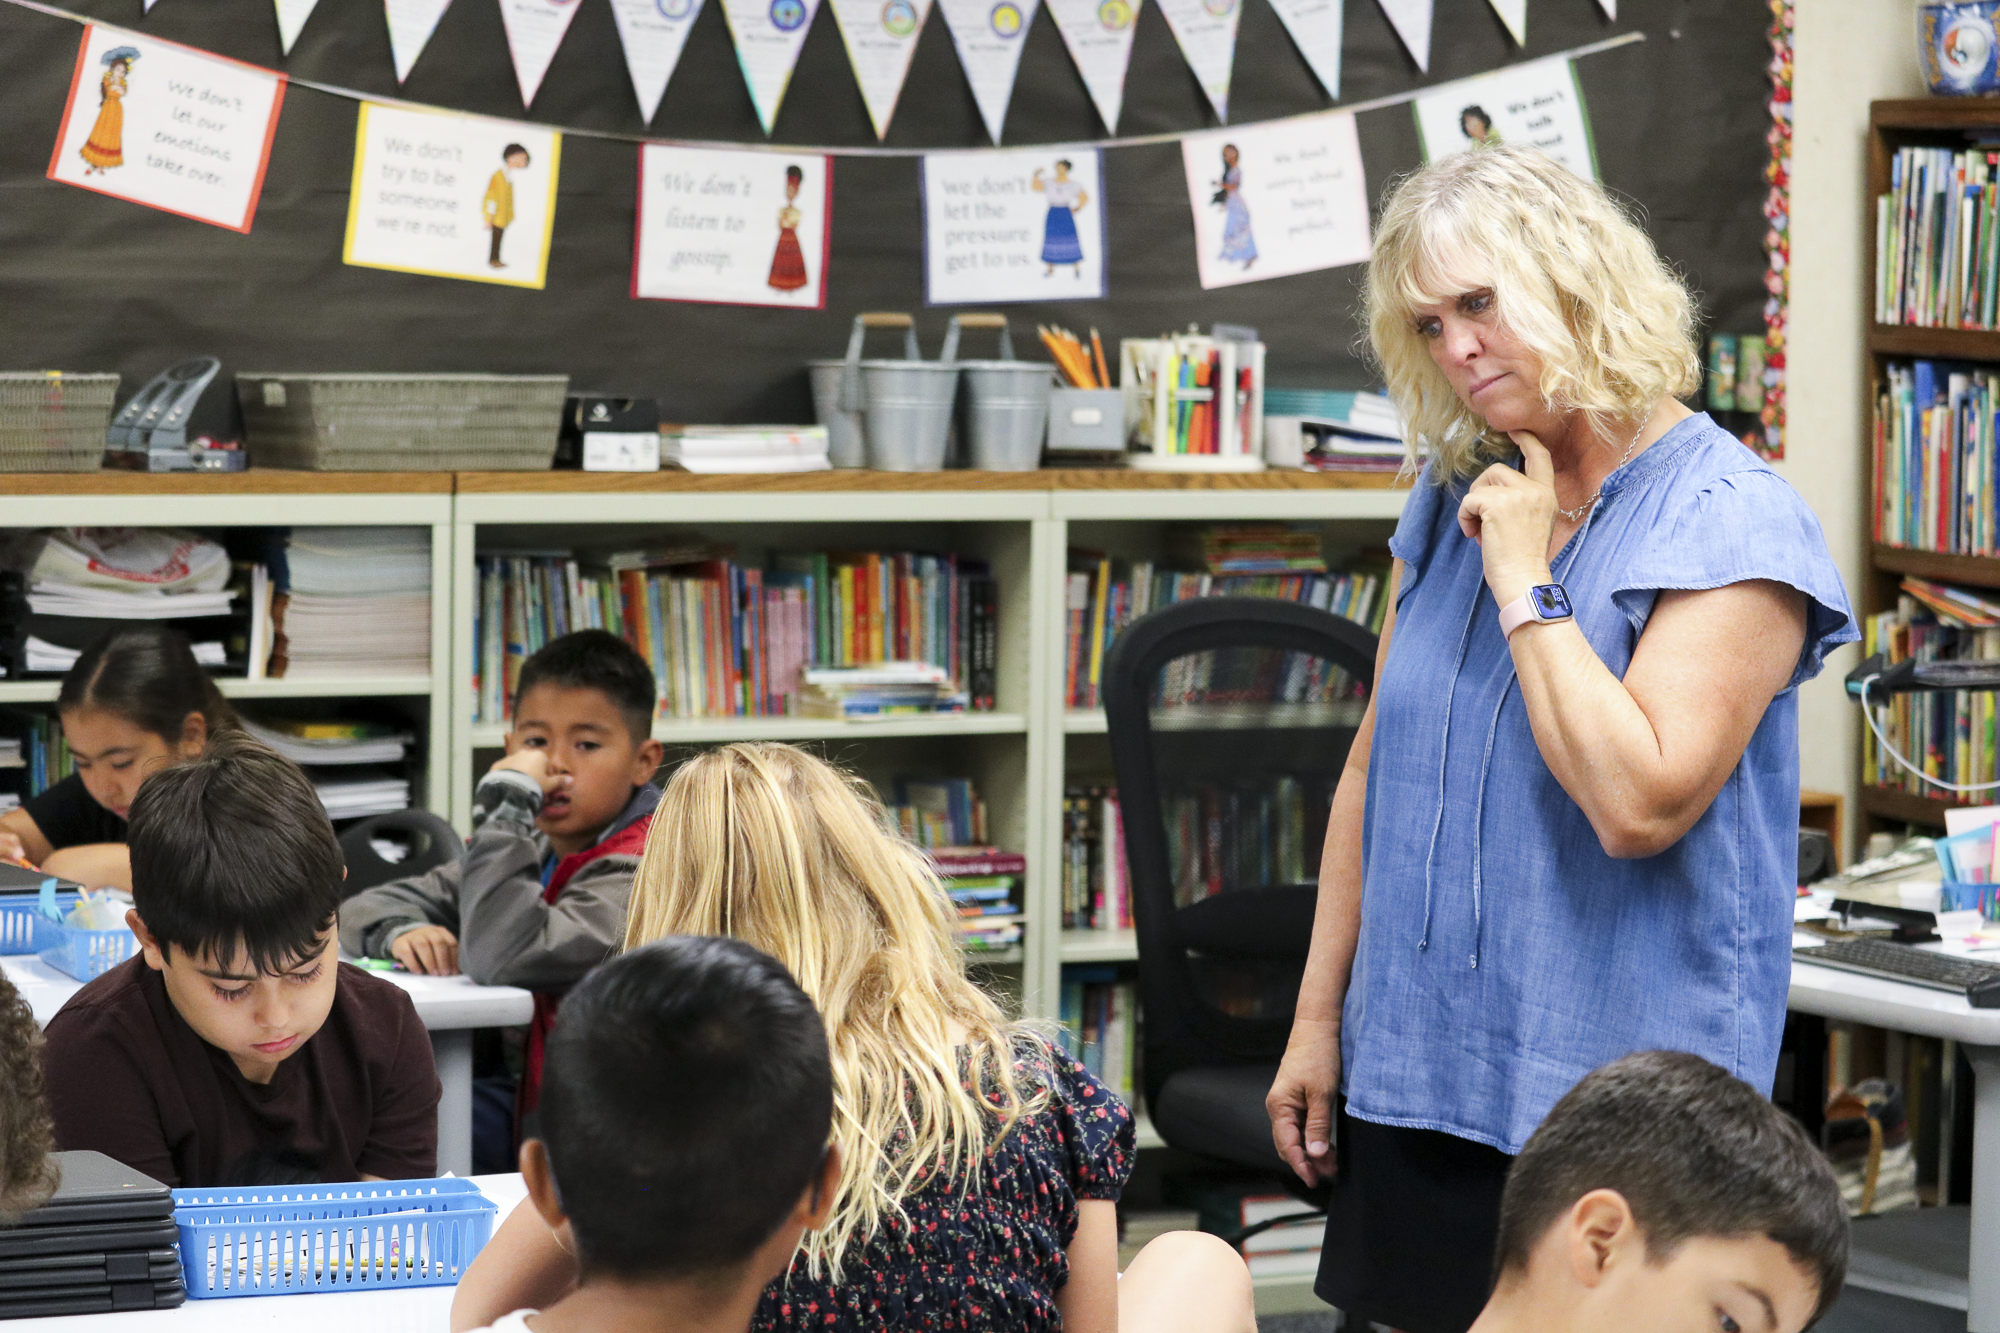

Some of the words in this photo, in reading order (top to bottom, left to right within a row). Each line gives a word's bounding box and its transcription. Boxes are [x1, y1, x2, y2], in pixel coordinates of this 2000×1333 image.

[168, 79, 195, 98] We
[198, 87, 243, 112] don't
[172, 106, 192, 124] let
[197, 117, 227, 132] our
[1505, 103, 1526, 115] We
[154, 131, 232, 162] emotions
[384, 136, 412, 156] We
[417, 142, 463, 163] don't
[146, 154, 184, 175] take
[382, 164, 406, 183] try
[411, 167, 428, 184] to
[434, 169, 455, 187] be
[661, 172, 696, 193] We
[700, 173, 752, 197] don't
[976, 176, 1028, 196] don't
[378, 190, 459, 214] someone
[943, 202, 969, 220] let
[974, 201, 1007, 220] the
[375, 216, 422, 234] we're
[665, 206, 719, 231] listen
[724, 214, 745, 233] to
[944, 228, 1031, 247] pressure
[945, 252, 978, 274] get
[982, 252, 1003, 267] to
